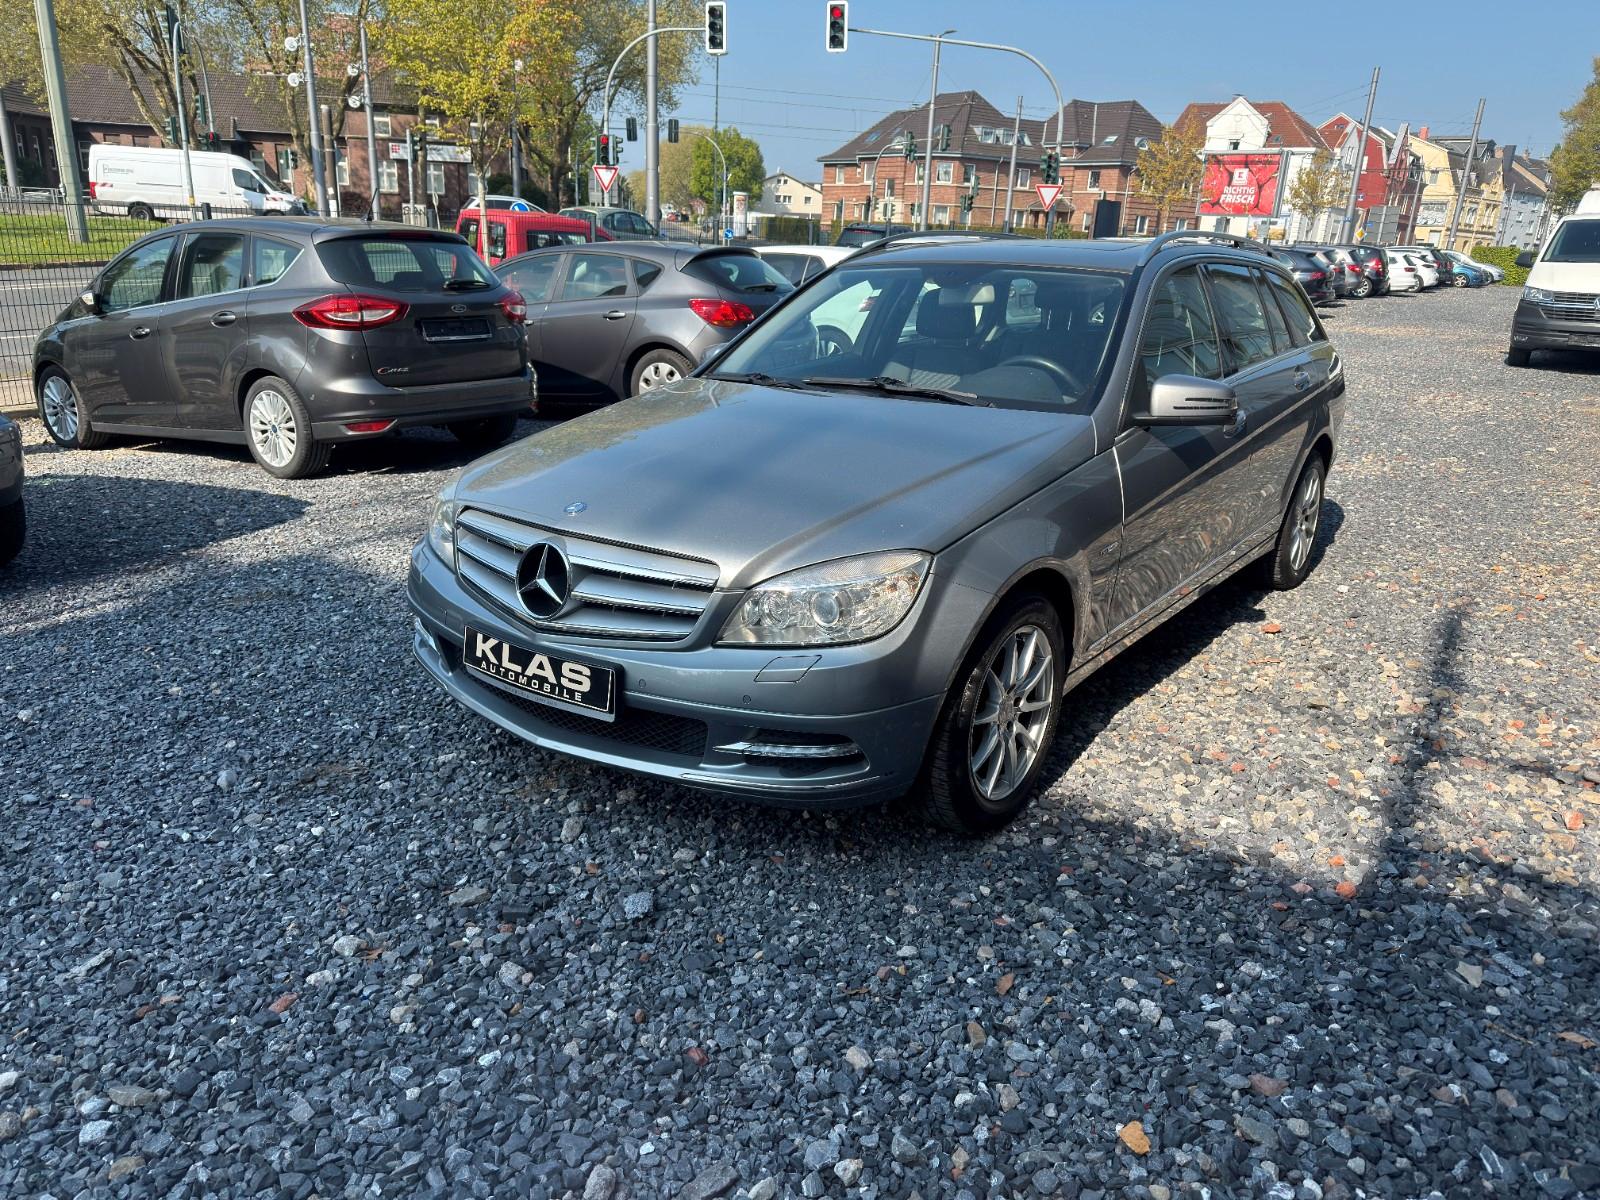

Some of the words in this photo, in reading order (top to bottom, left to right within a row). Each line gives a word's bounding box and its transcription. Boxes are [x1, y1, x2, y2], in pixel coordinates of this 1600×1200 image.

[1220, 194, 1255, 204] FRISCH
[1223, 186, 1255, 194] RICHTIG
[475, 633, 591, 692] KLAS
[480, 661, 582, 702] AUTOMOBILE
